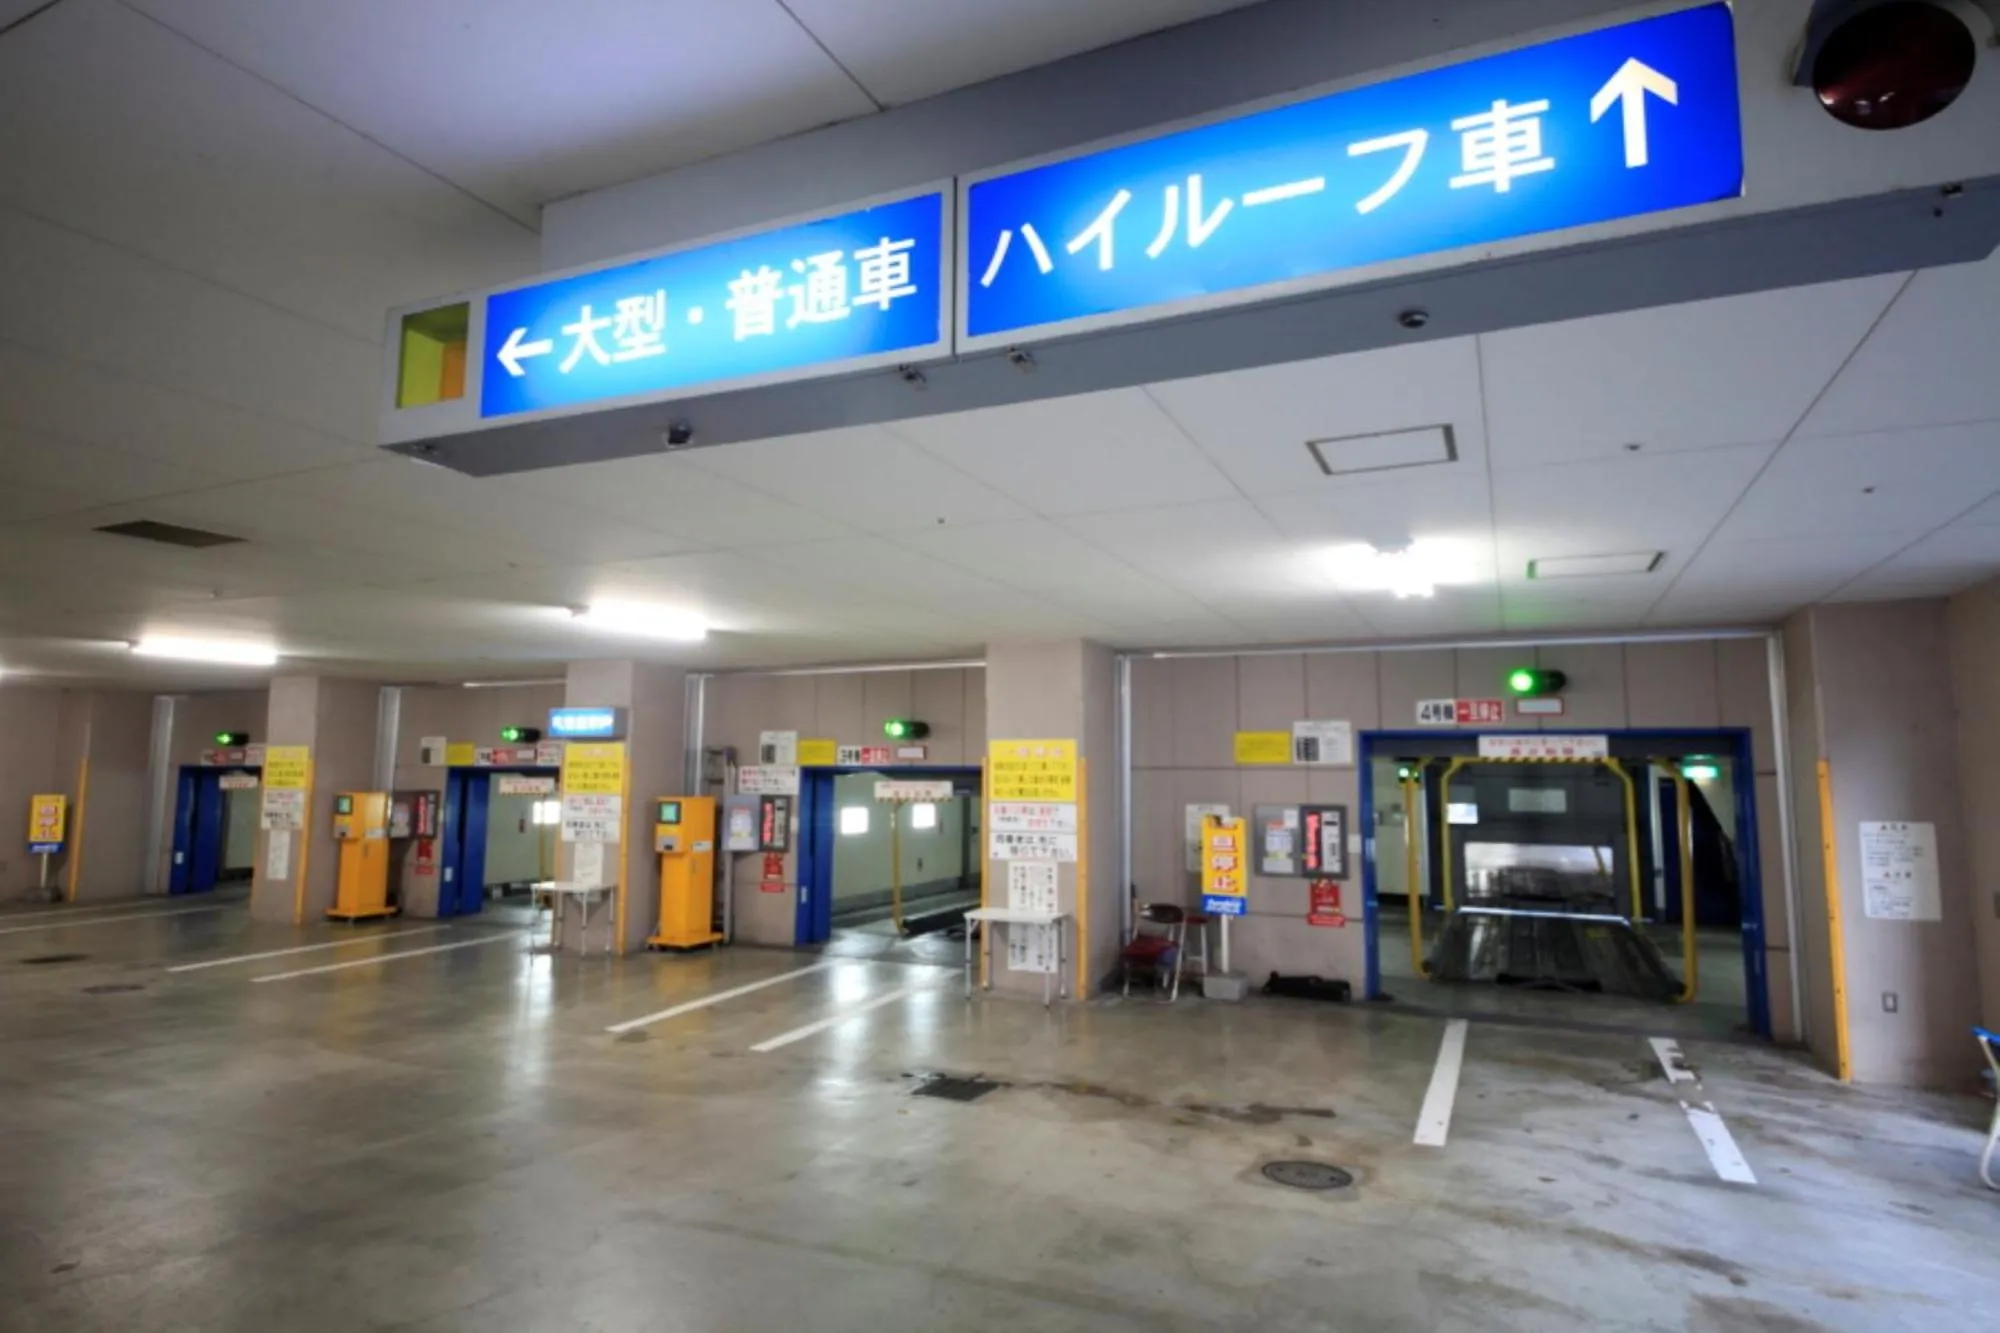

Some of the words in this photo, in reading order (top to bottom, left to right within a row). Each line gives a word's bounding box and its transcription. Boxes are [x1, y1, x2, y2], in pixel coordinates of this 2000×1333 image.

[979, 98, 1556, 289] ハイルーフ車
[559, 235, 918, 374] 大型・普通車
